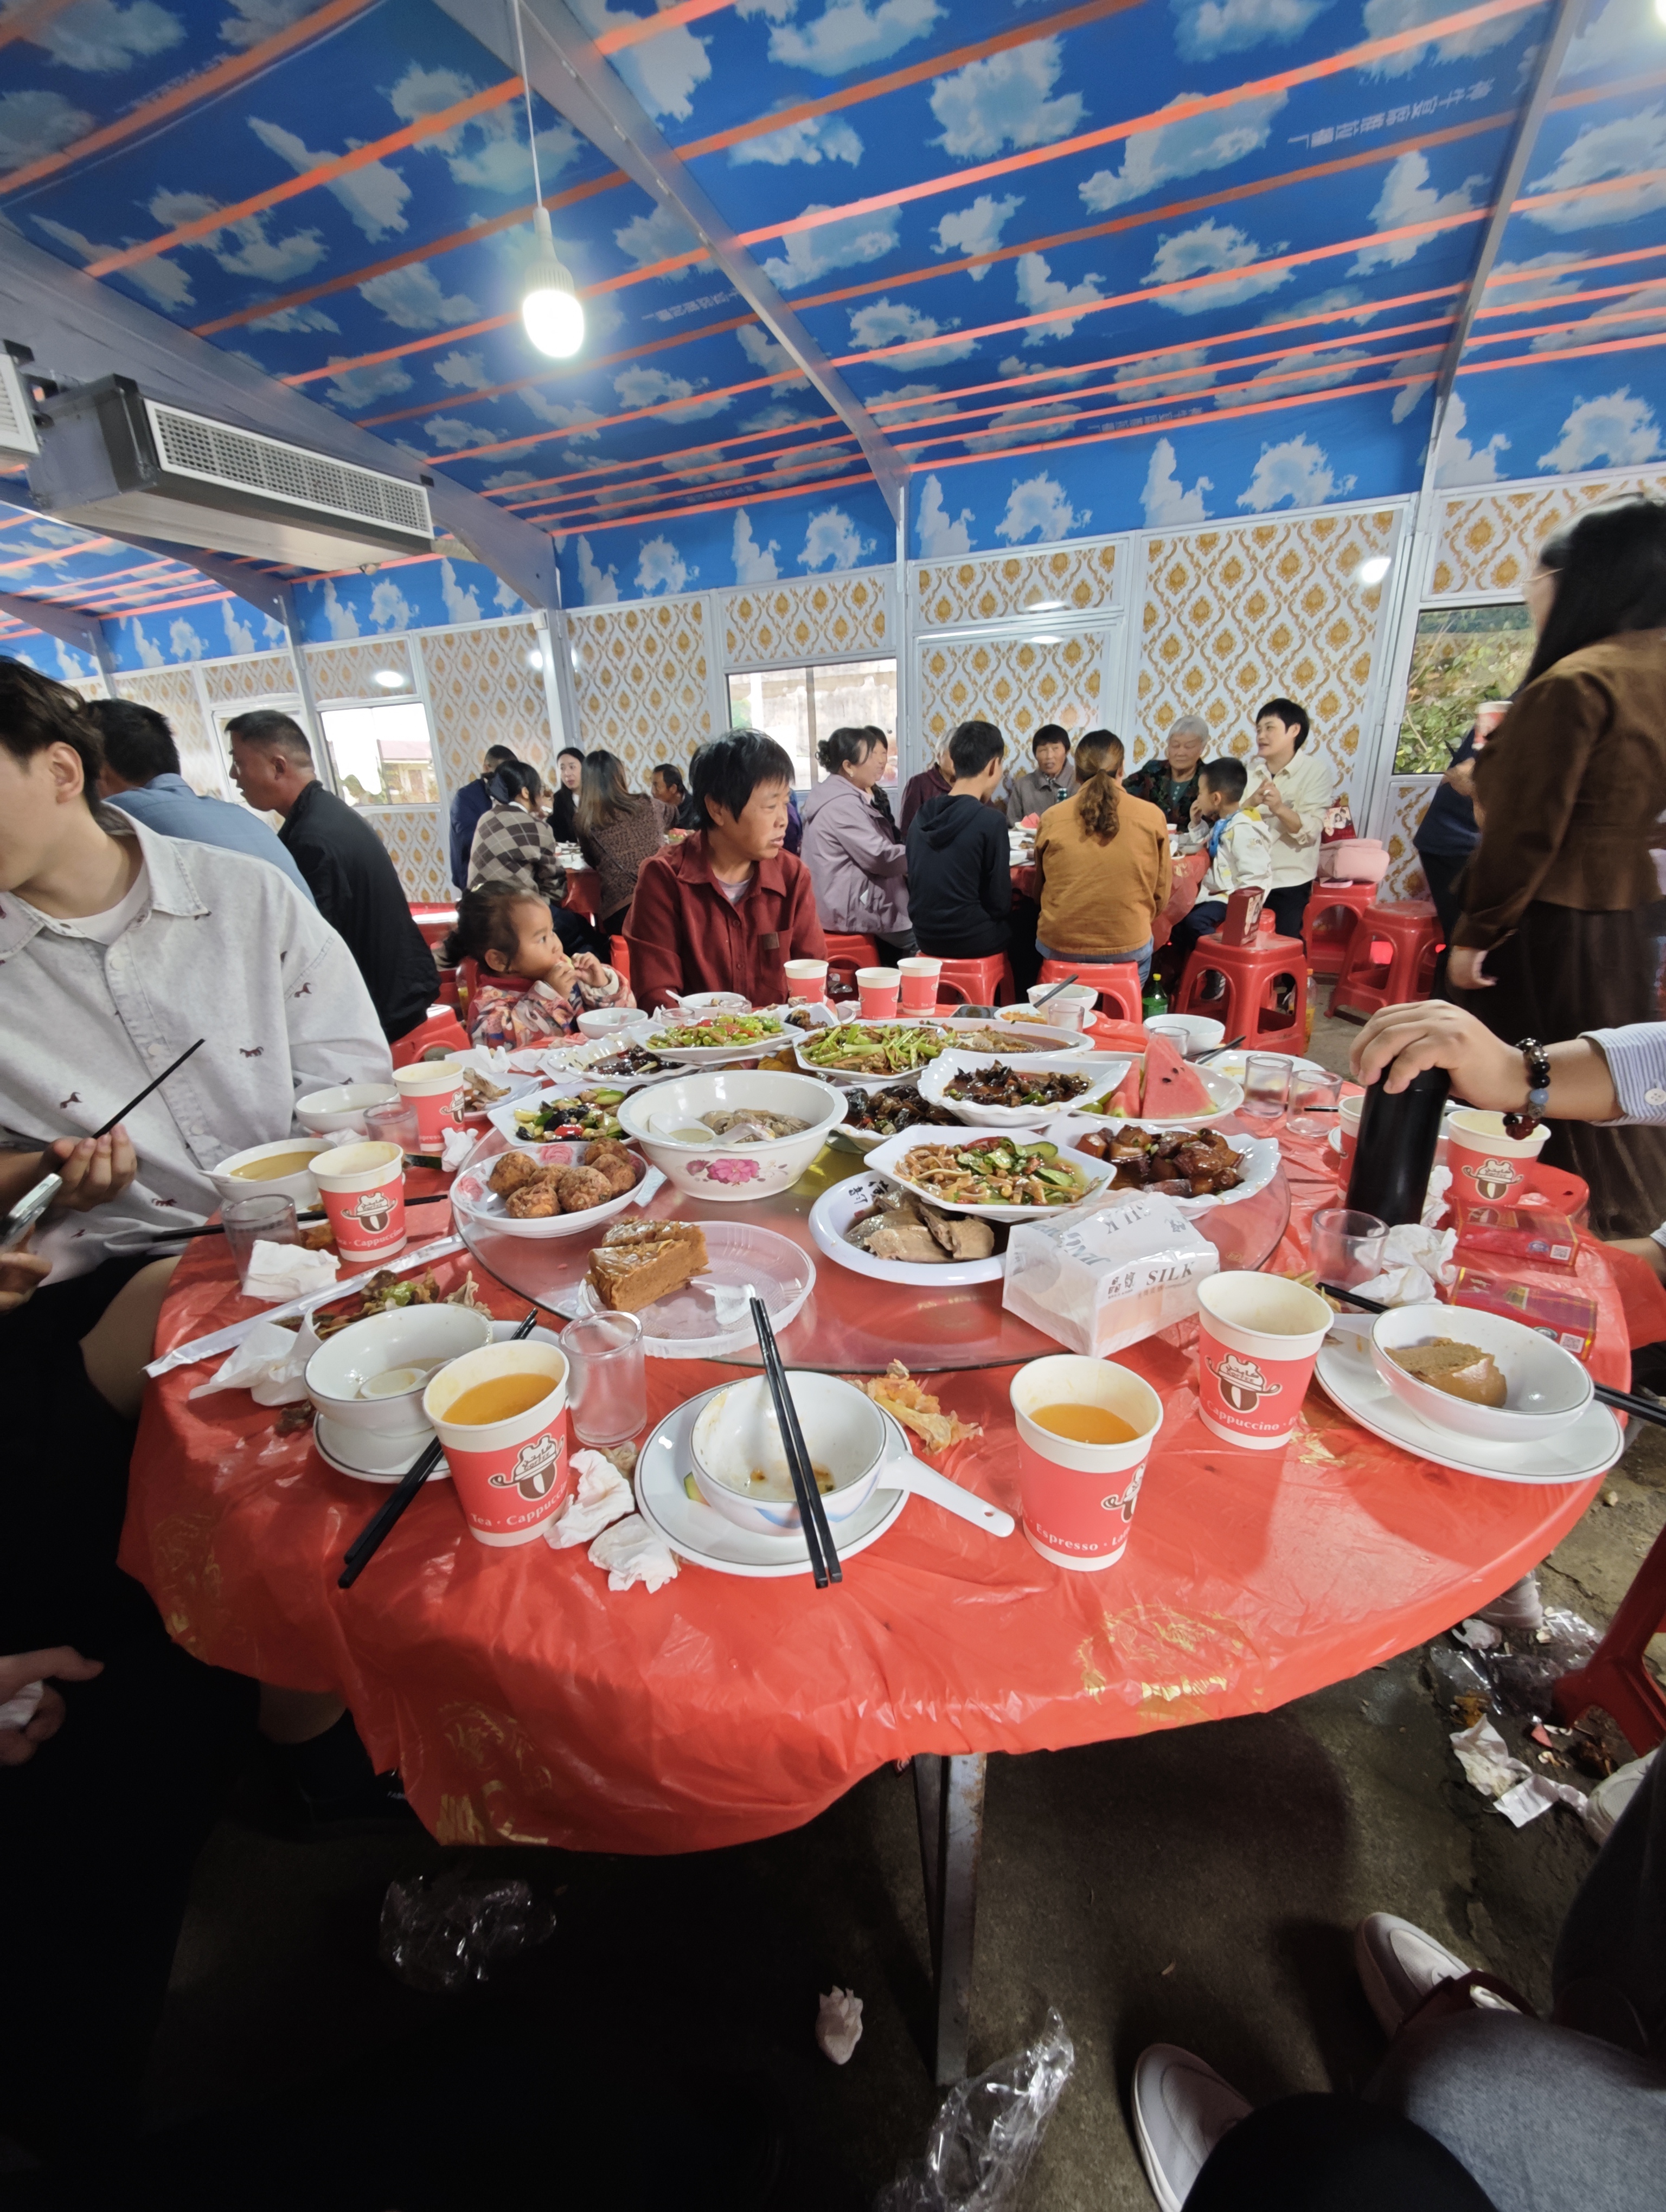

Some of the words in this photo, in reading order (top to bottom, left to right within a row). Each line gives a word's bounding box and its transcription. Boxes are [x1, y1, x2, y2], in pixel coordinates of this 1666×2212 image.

[354, 1226, 403, 1248] Cappuccino
[1146, 1261, 1195, 1285] SILK
[1207, 1400, 1280, 1431] Cappuccino
[470, 1513, 492, 1526] Tea
[506, 1481, 568, 1526] Cappuccin
[1036, 1522, 1099, 1551] Espresso
